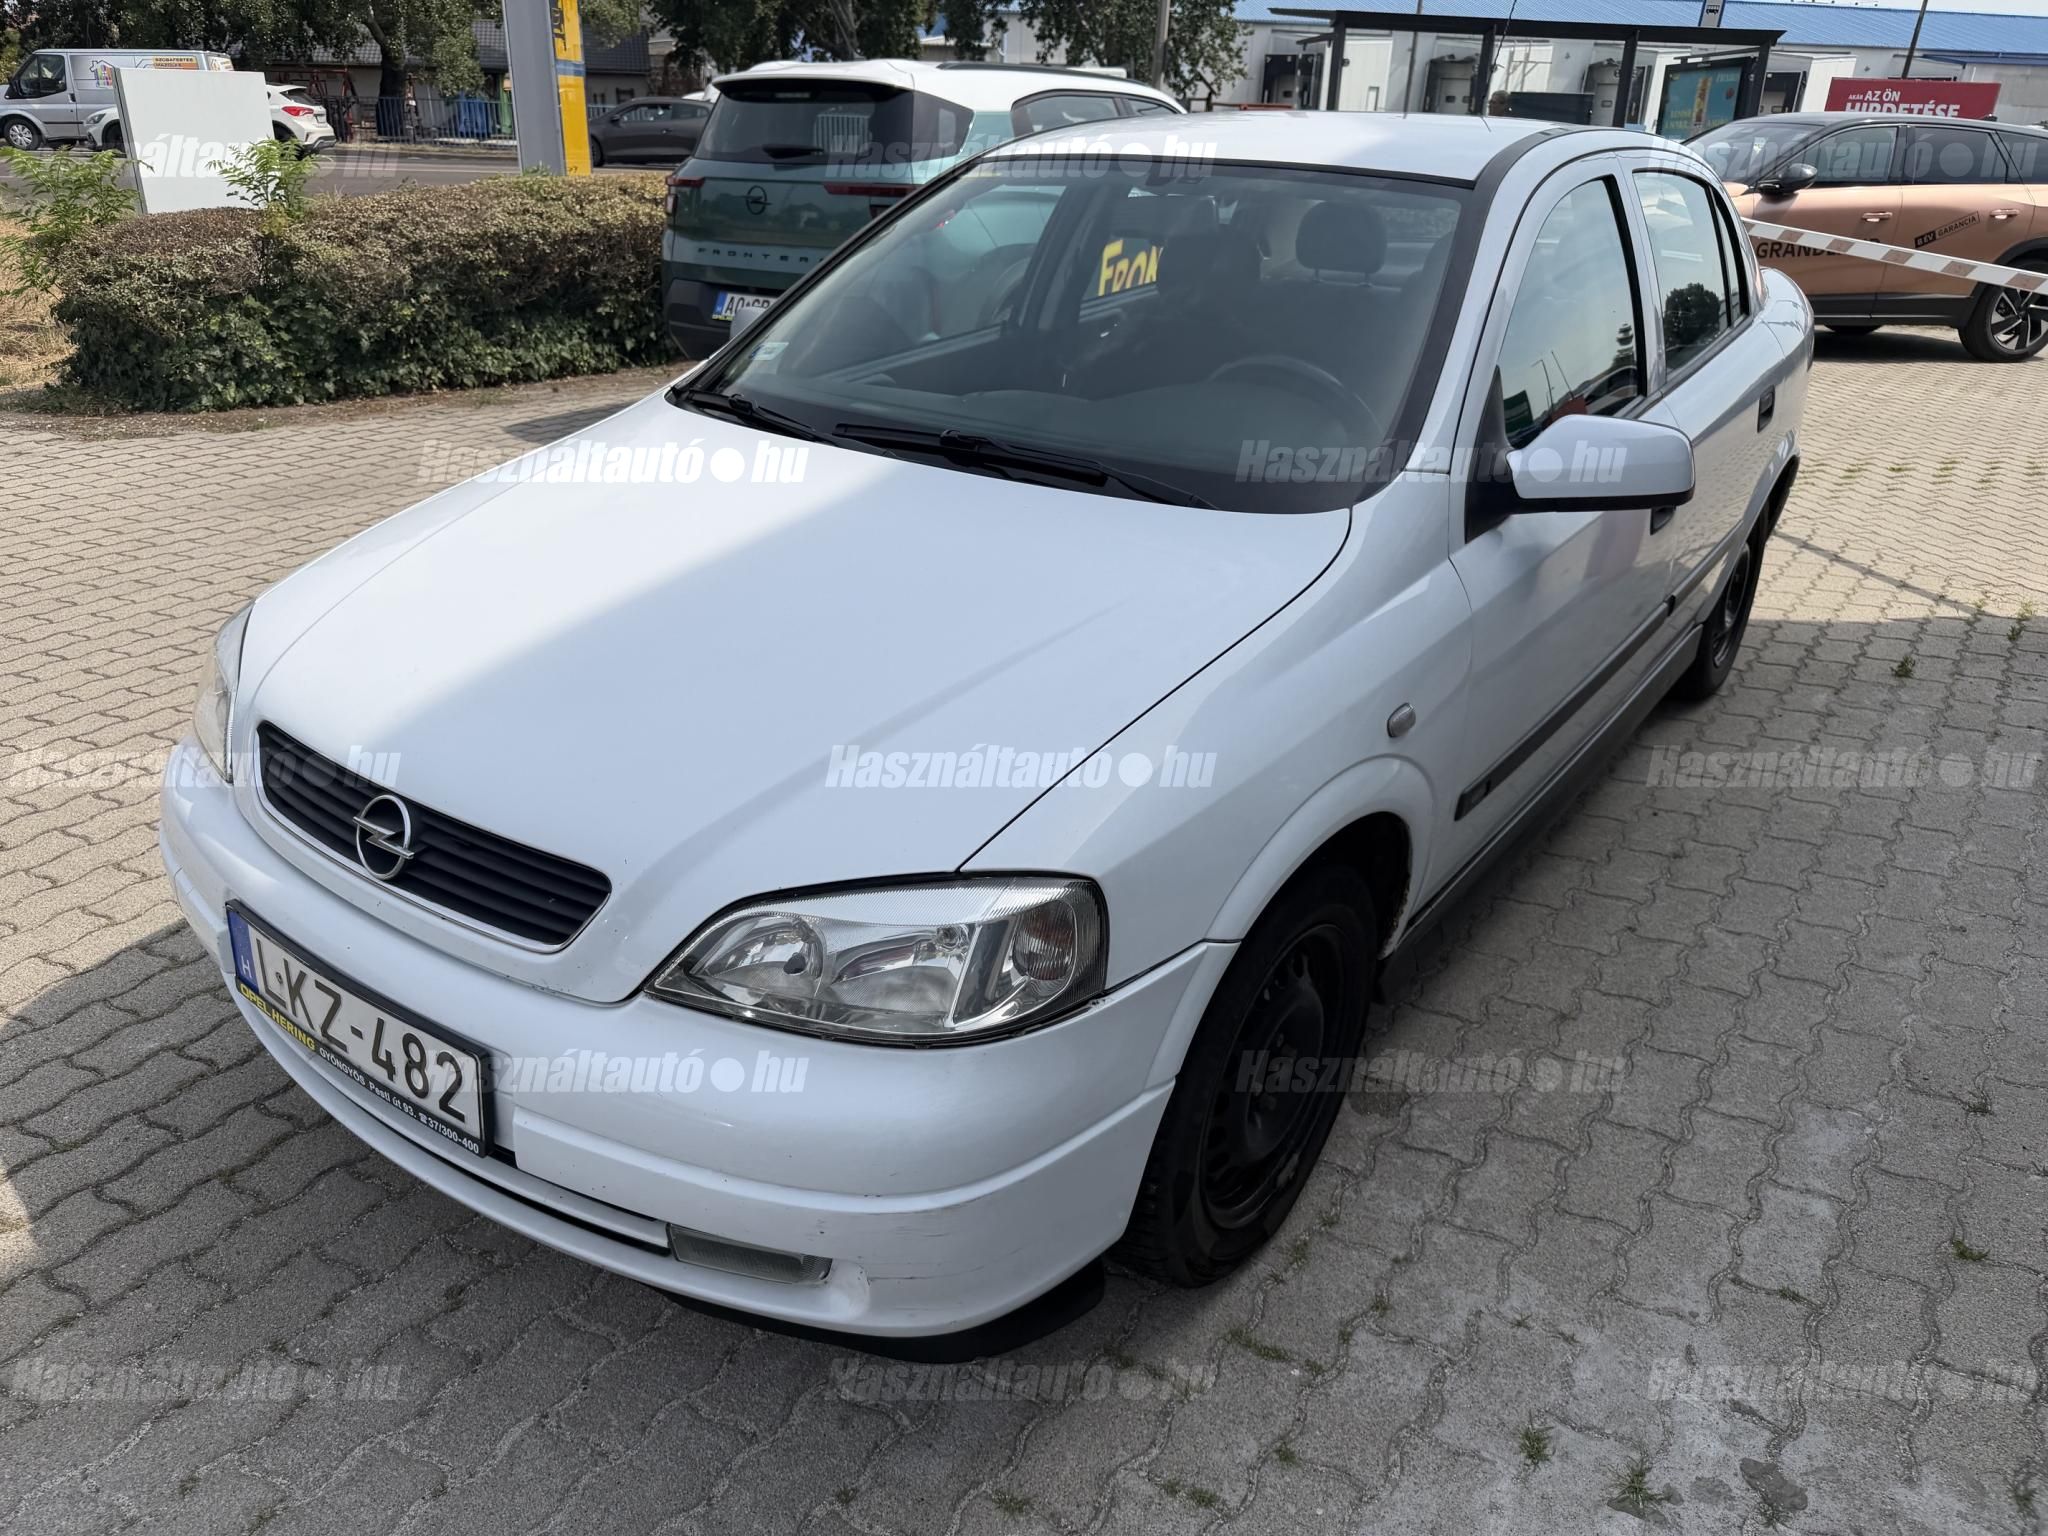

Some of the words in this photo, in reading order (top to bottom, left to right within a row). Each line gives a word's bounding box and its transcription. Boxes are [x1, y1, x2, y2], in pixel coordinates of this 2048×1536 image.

[1864, 90, 1881, 101] AZ
[1882, 88, 1901, 102] ÖN
[240, 955, 252, 979] H
[240, 983, 271, 1016] OPEL
[271, 1008, 316, 1051] HERING
[319, 1047, 366, 1086] GYÖNGYÖS
[368, 1081, 391, 1103] Pesti
[392, 1095, 402, 1110] út
[403, 1103, 417, 1118] 93.
[256, 938, 466, 1123] LKZ-482
